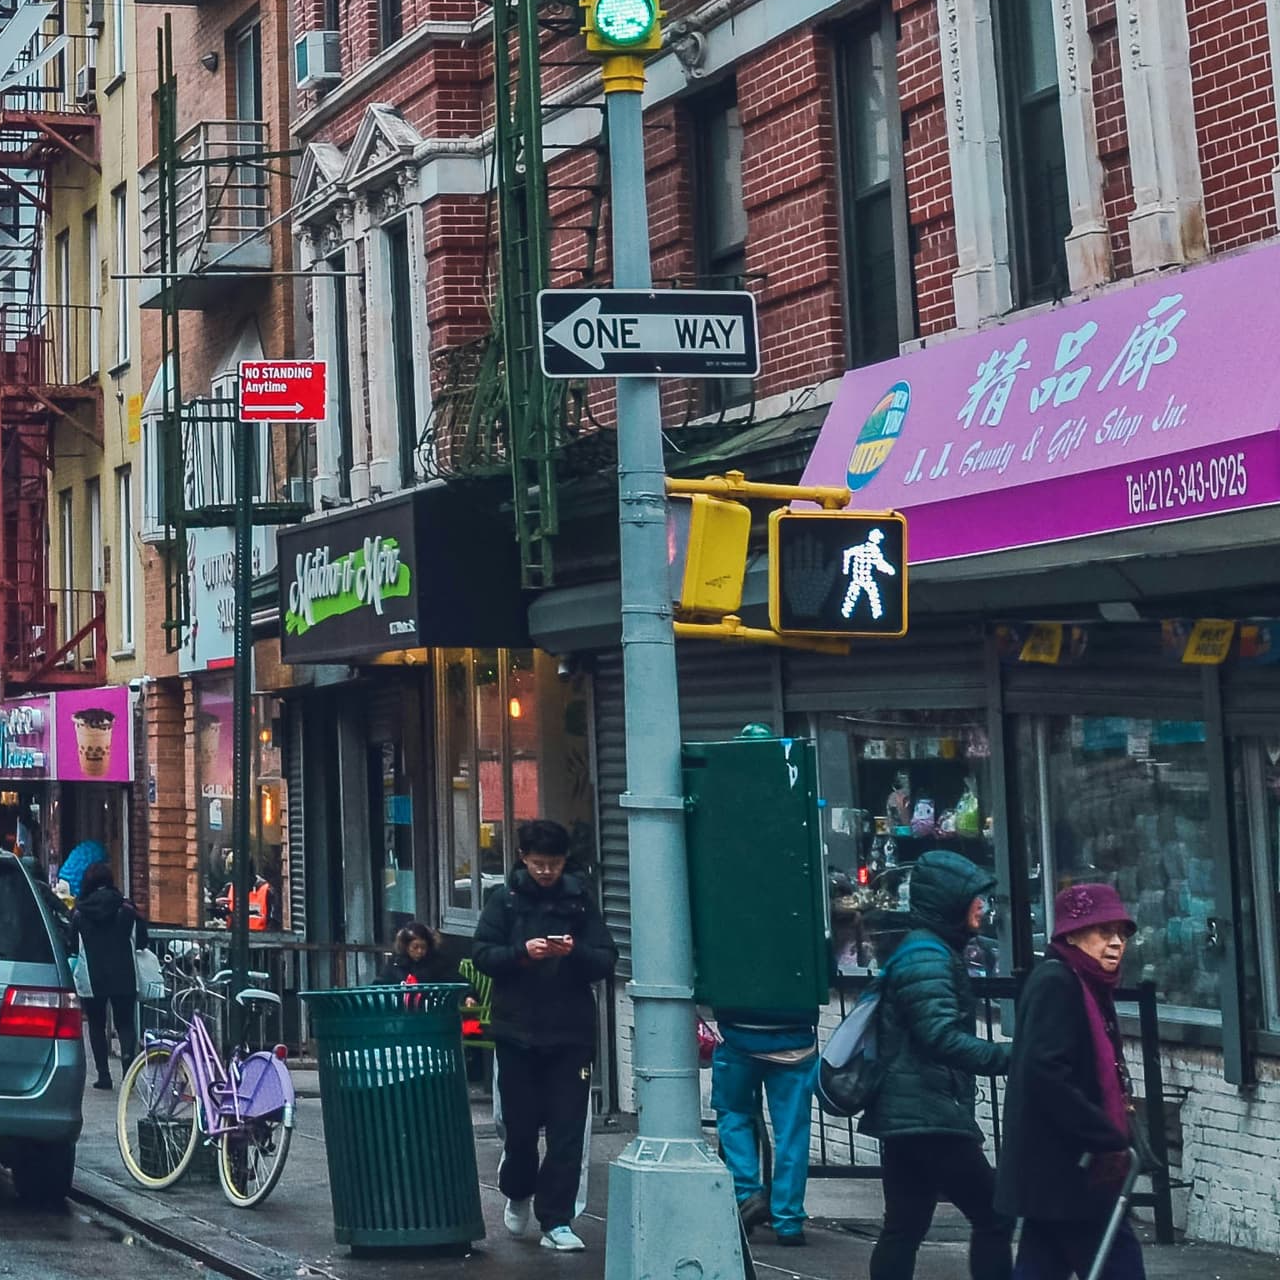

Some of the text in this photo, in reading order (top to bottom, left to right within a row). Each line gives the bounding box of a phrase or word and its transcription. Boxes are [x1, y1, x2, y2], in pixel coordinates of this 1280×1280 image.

[573, 317, 737, 349] ONE WAY
[245, 367, 313, 379] NO STANDING
[957, 293, 1187, 430] 精品廊
[245, 380, 288, 395] Anytime
[1047, 416, 1089, 464] Gift
[1095, 405, 1144, 448] Shop
[1125, 452, 1248, 515] Tel:212-343-0925
